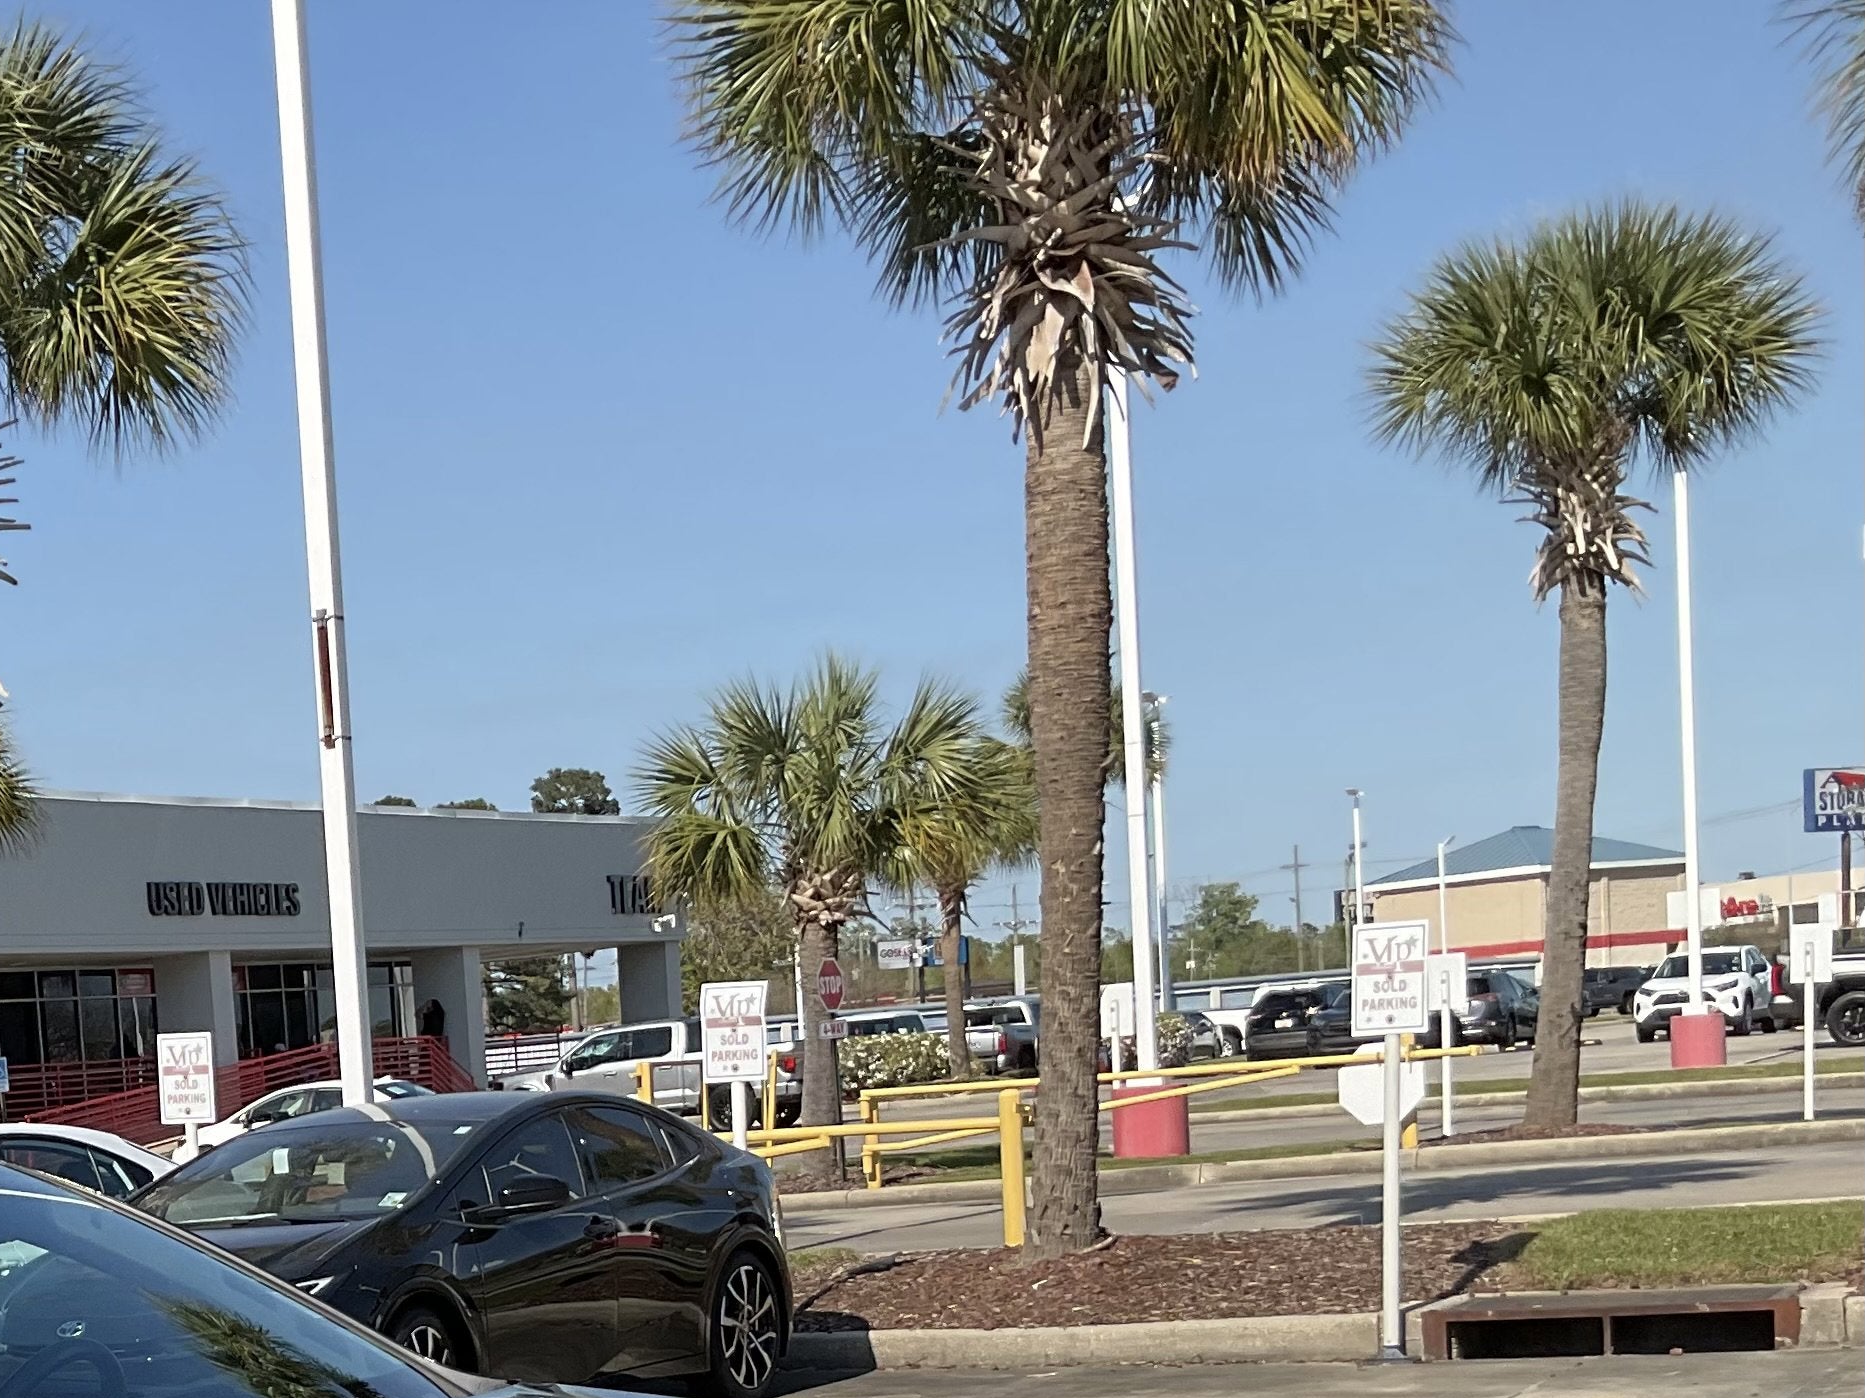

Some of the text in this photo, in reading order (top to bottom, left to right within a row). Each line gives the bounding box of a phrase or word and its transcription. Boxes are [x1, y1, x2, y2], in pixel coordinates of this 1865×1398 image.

[146, 882, 301, 916] USED VEHICLES
[818, 975, 842, 995] STOP
[1373, 979, 1407, 993] SOLD
[1361, 996, 1417, 1012] PARKING
[720, 1033, 749, 1046] SOLD
[711, 1049, 758, 1062] PARKING
[174, 1079, 198, 1091] SOLD
[167, 1093, 207, 1104] PARKING
